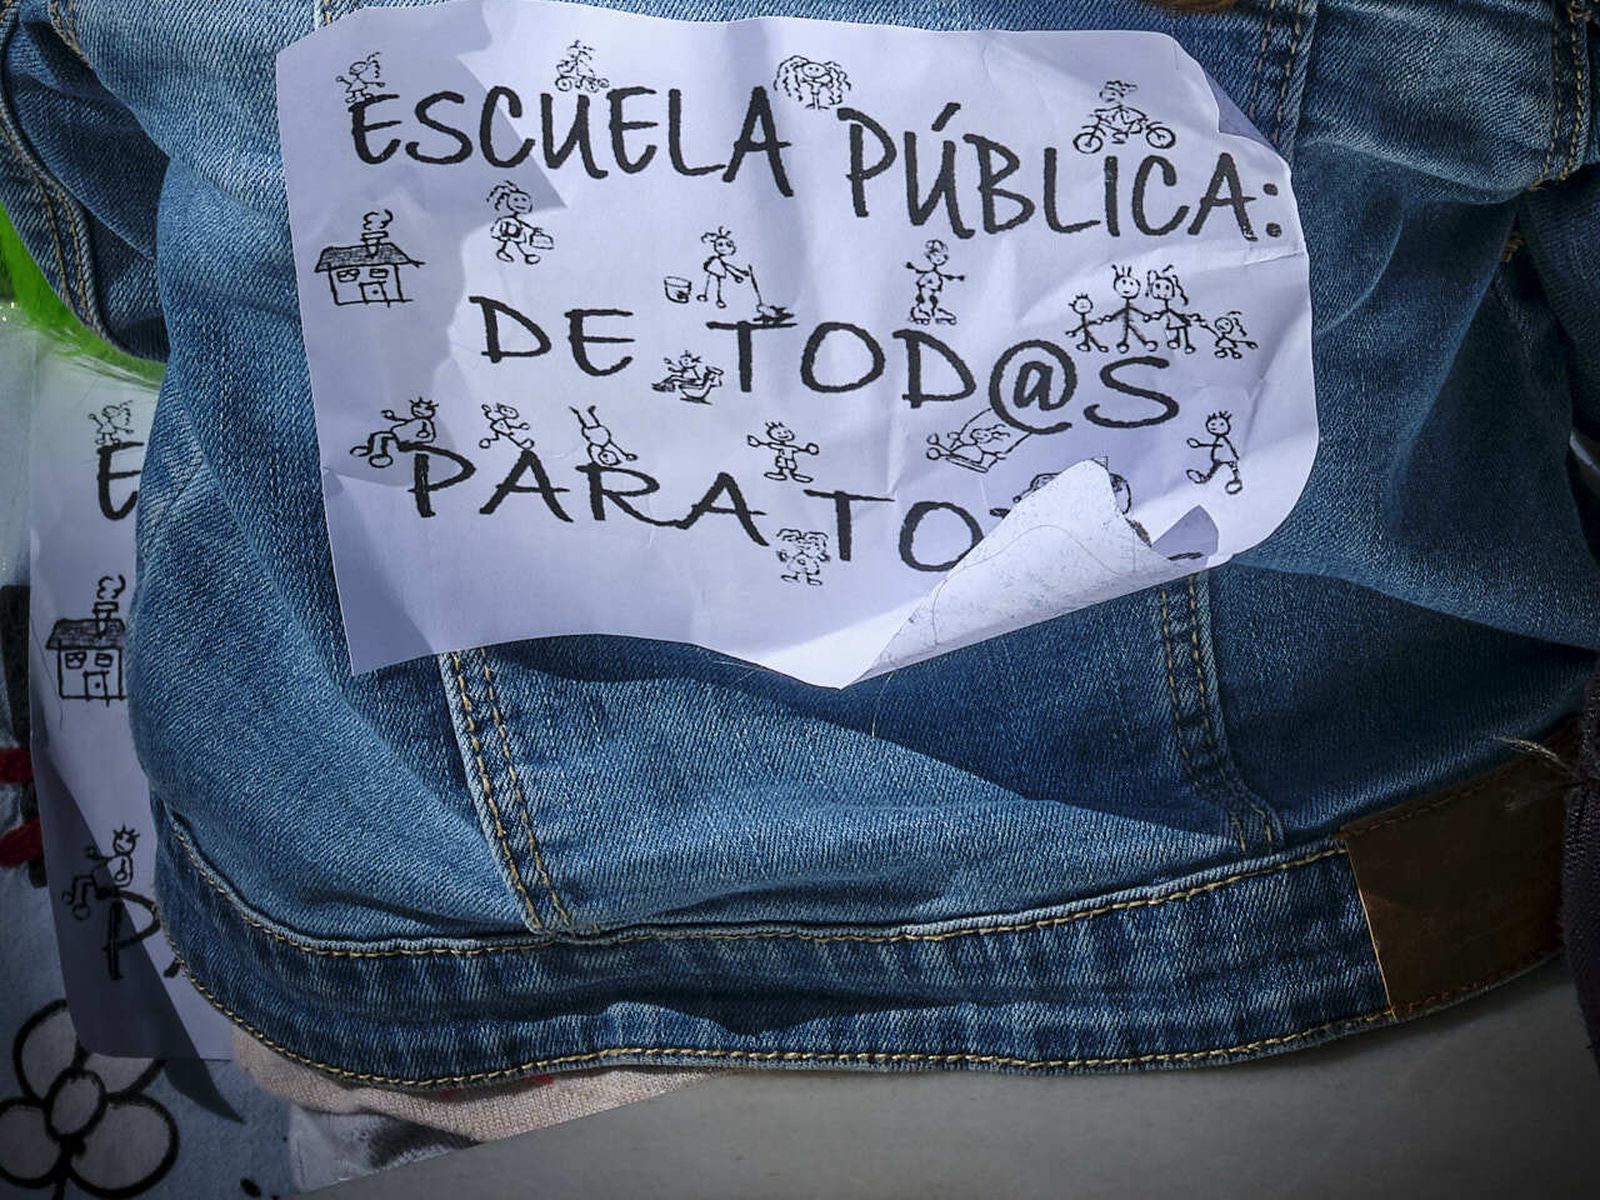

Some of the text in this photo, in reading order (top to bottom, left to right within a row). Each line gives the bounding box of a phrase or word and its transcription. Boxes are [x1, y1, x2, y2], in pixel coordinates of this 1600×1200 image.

[349, 85, 1282, 242] ESCUELA PÚBLICA:
[467, 295, 1180, 434] DE TOD@S
[398, 440, 1009, 572] PARA TO
